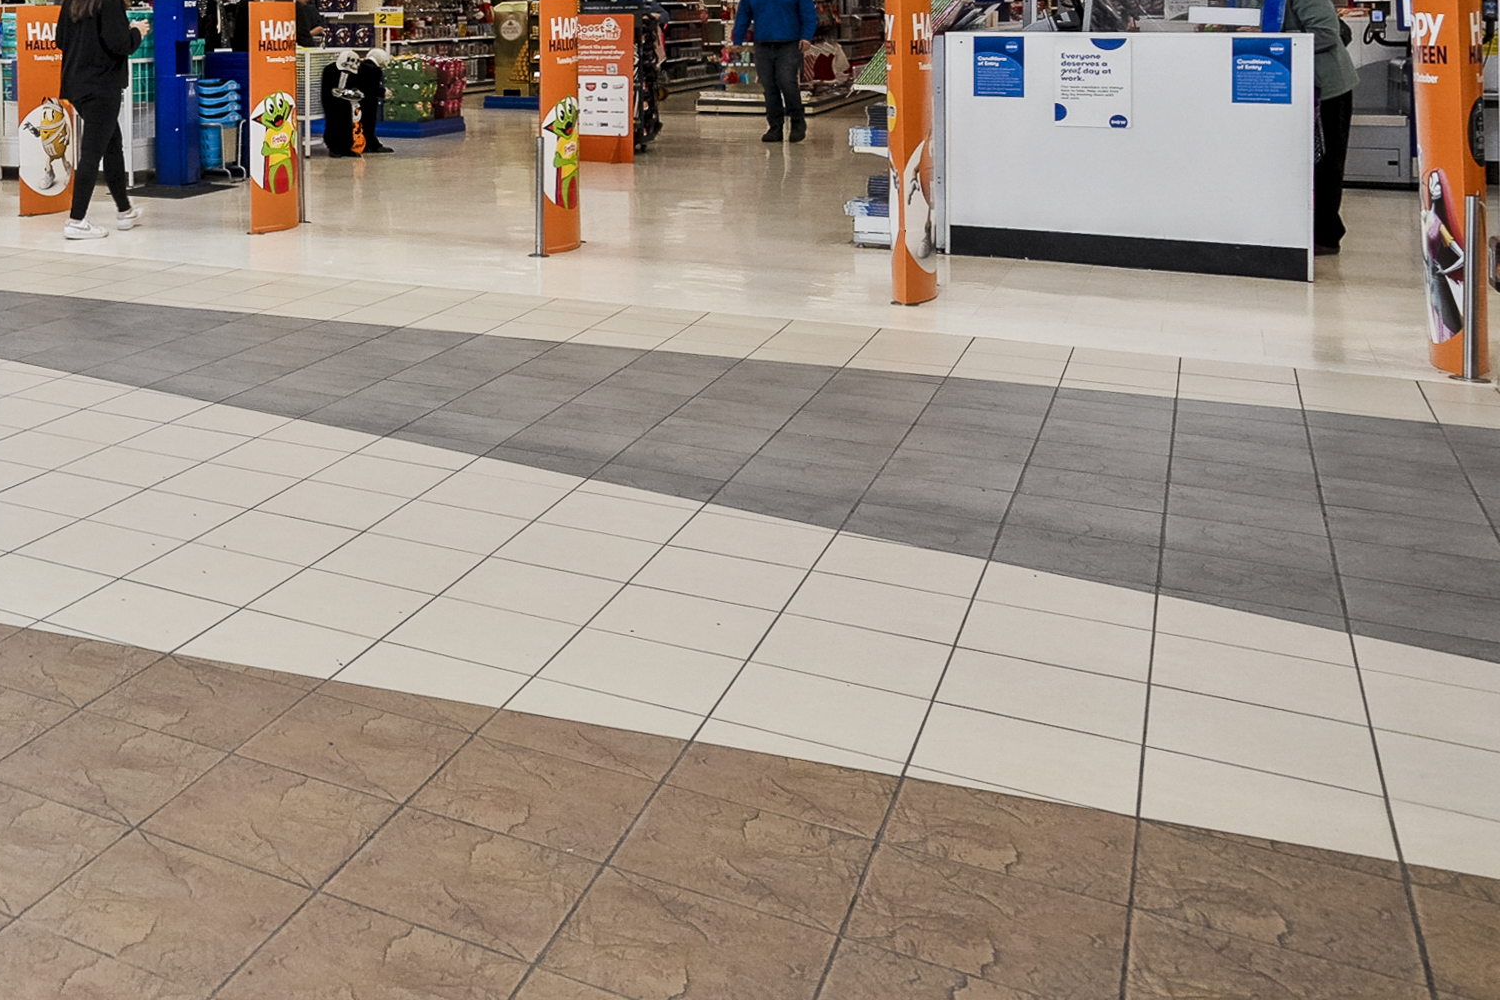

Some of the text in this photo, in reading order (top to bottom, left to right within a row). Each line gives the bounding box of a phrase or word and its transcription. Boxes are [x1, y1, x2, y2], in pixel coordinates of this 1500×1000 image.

[260, 19, 296, 41] HAPP
[550, 16, 578, 40] HAP
[1411, 12, 1445, 46] PPY
[26, 41, 58, 50] HALLO
